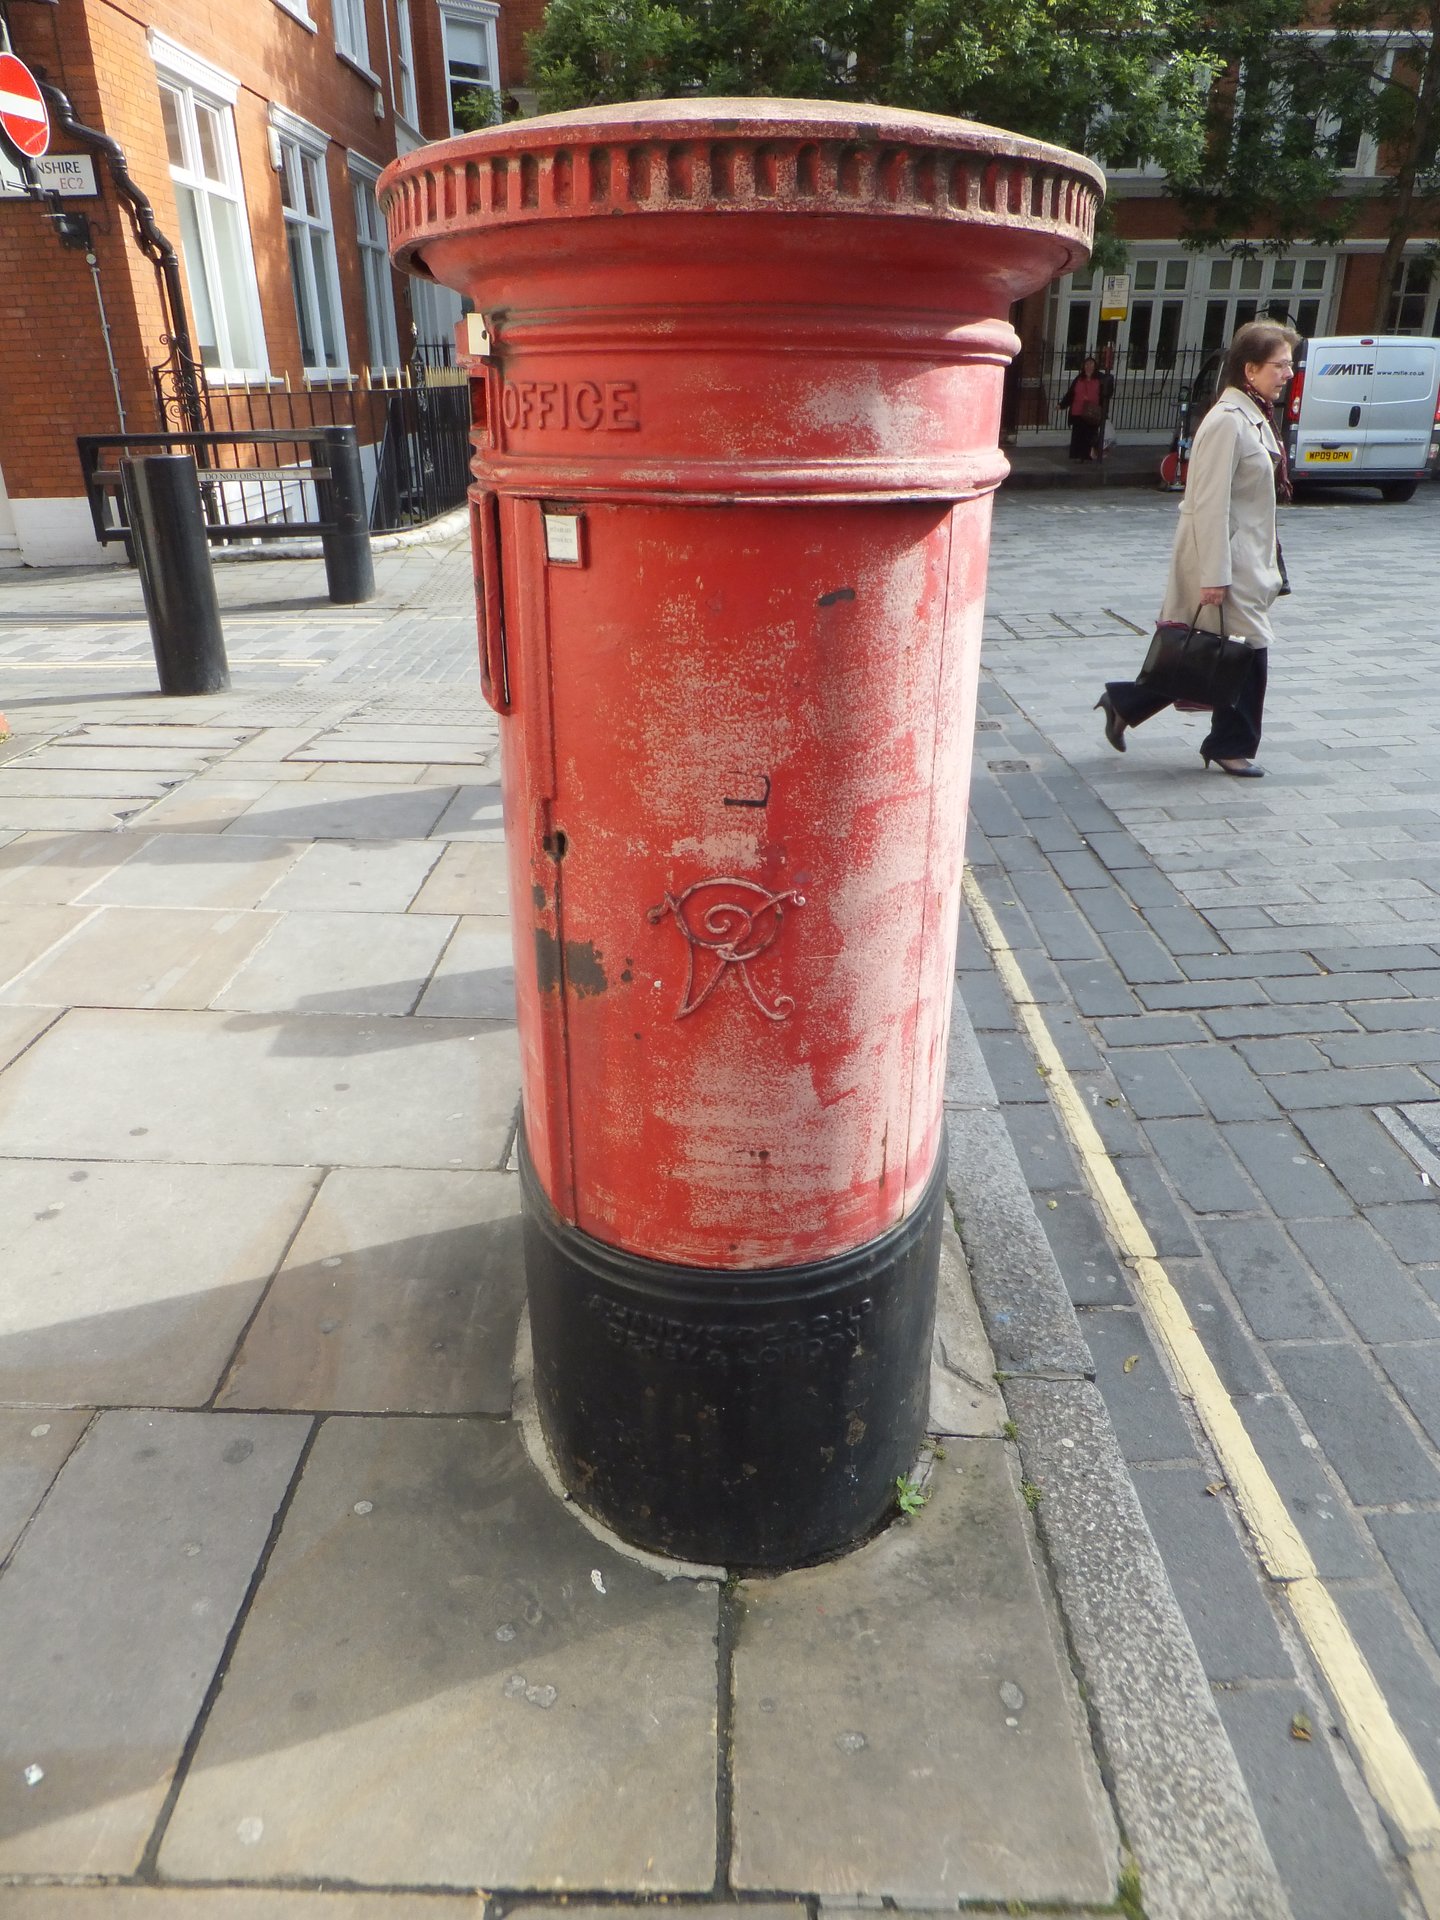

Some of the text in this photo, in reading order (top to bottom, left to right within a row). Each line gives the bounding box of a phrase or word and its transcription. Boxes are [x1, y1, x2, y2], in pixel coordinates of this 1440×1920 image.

[36, 162, 81, 174] NSHIRE
[60, 178, 84, 190] EC2
[1335, 364, 1374, 375] MITIE
[502, 382, 640, 431] OFFICE
[220, 472, 237, 480] NOT
[240, 471, 285, 480] OBSTRUCT
